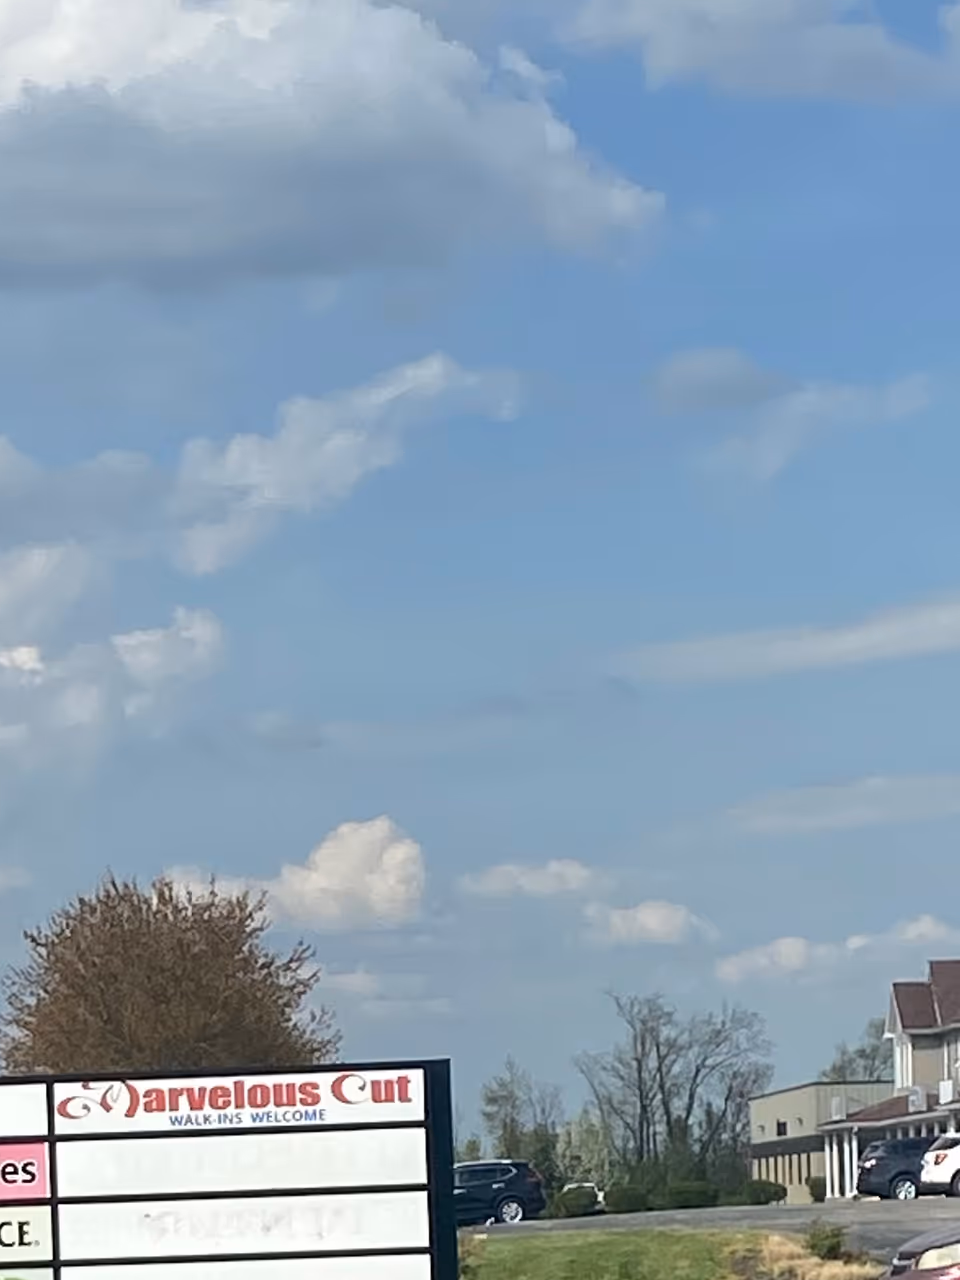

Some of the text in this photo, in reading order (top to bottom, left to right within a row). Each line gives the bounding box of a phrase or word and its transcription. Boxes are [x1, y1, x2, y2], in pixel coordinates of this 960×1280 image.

[330, 1073, 413, 1105] Cut
[169, 1108, 328, 1127] WALK-INS WELCOME
